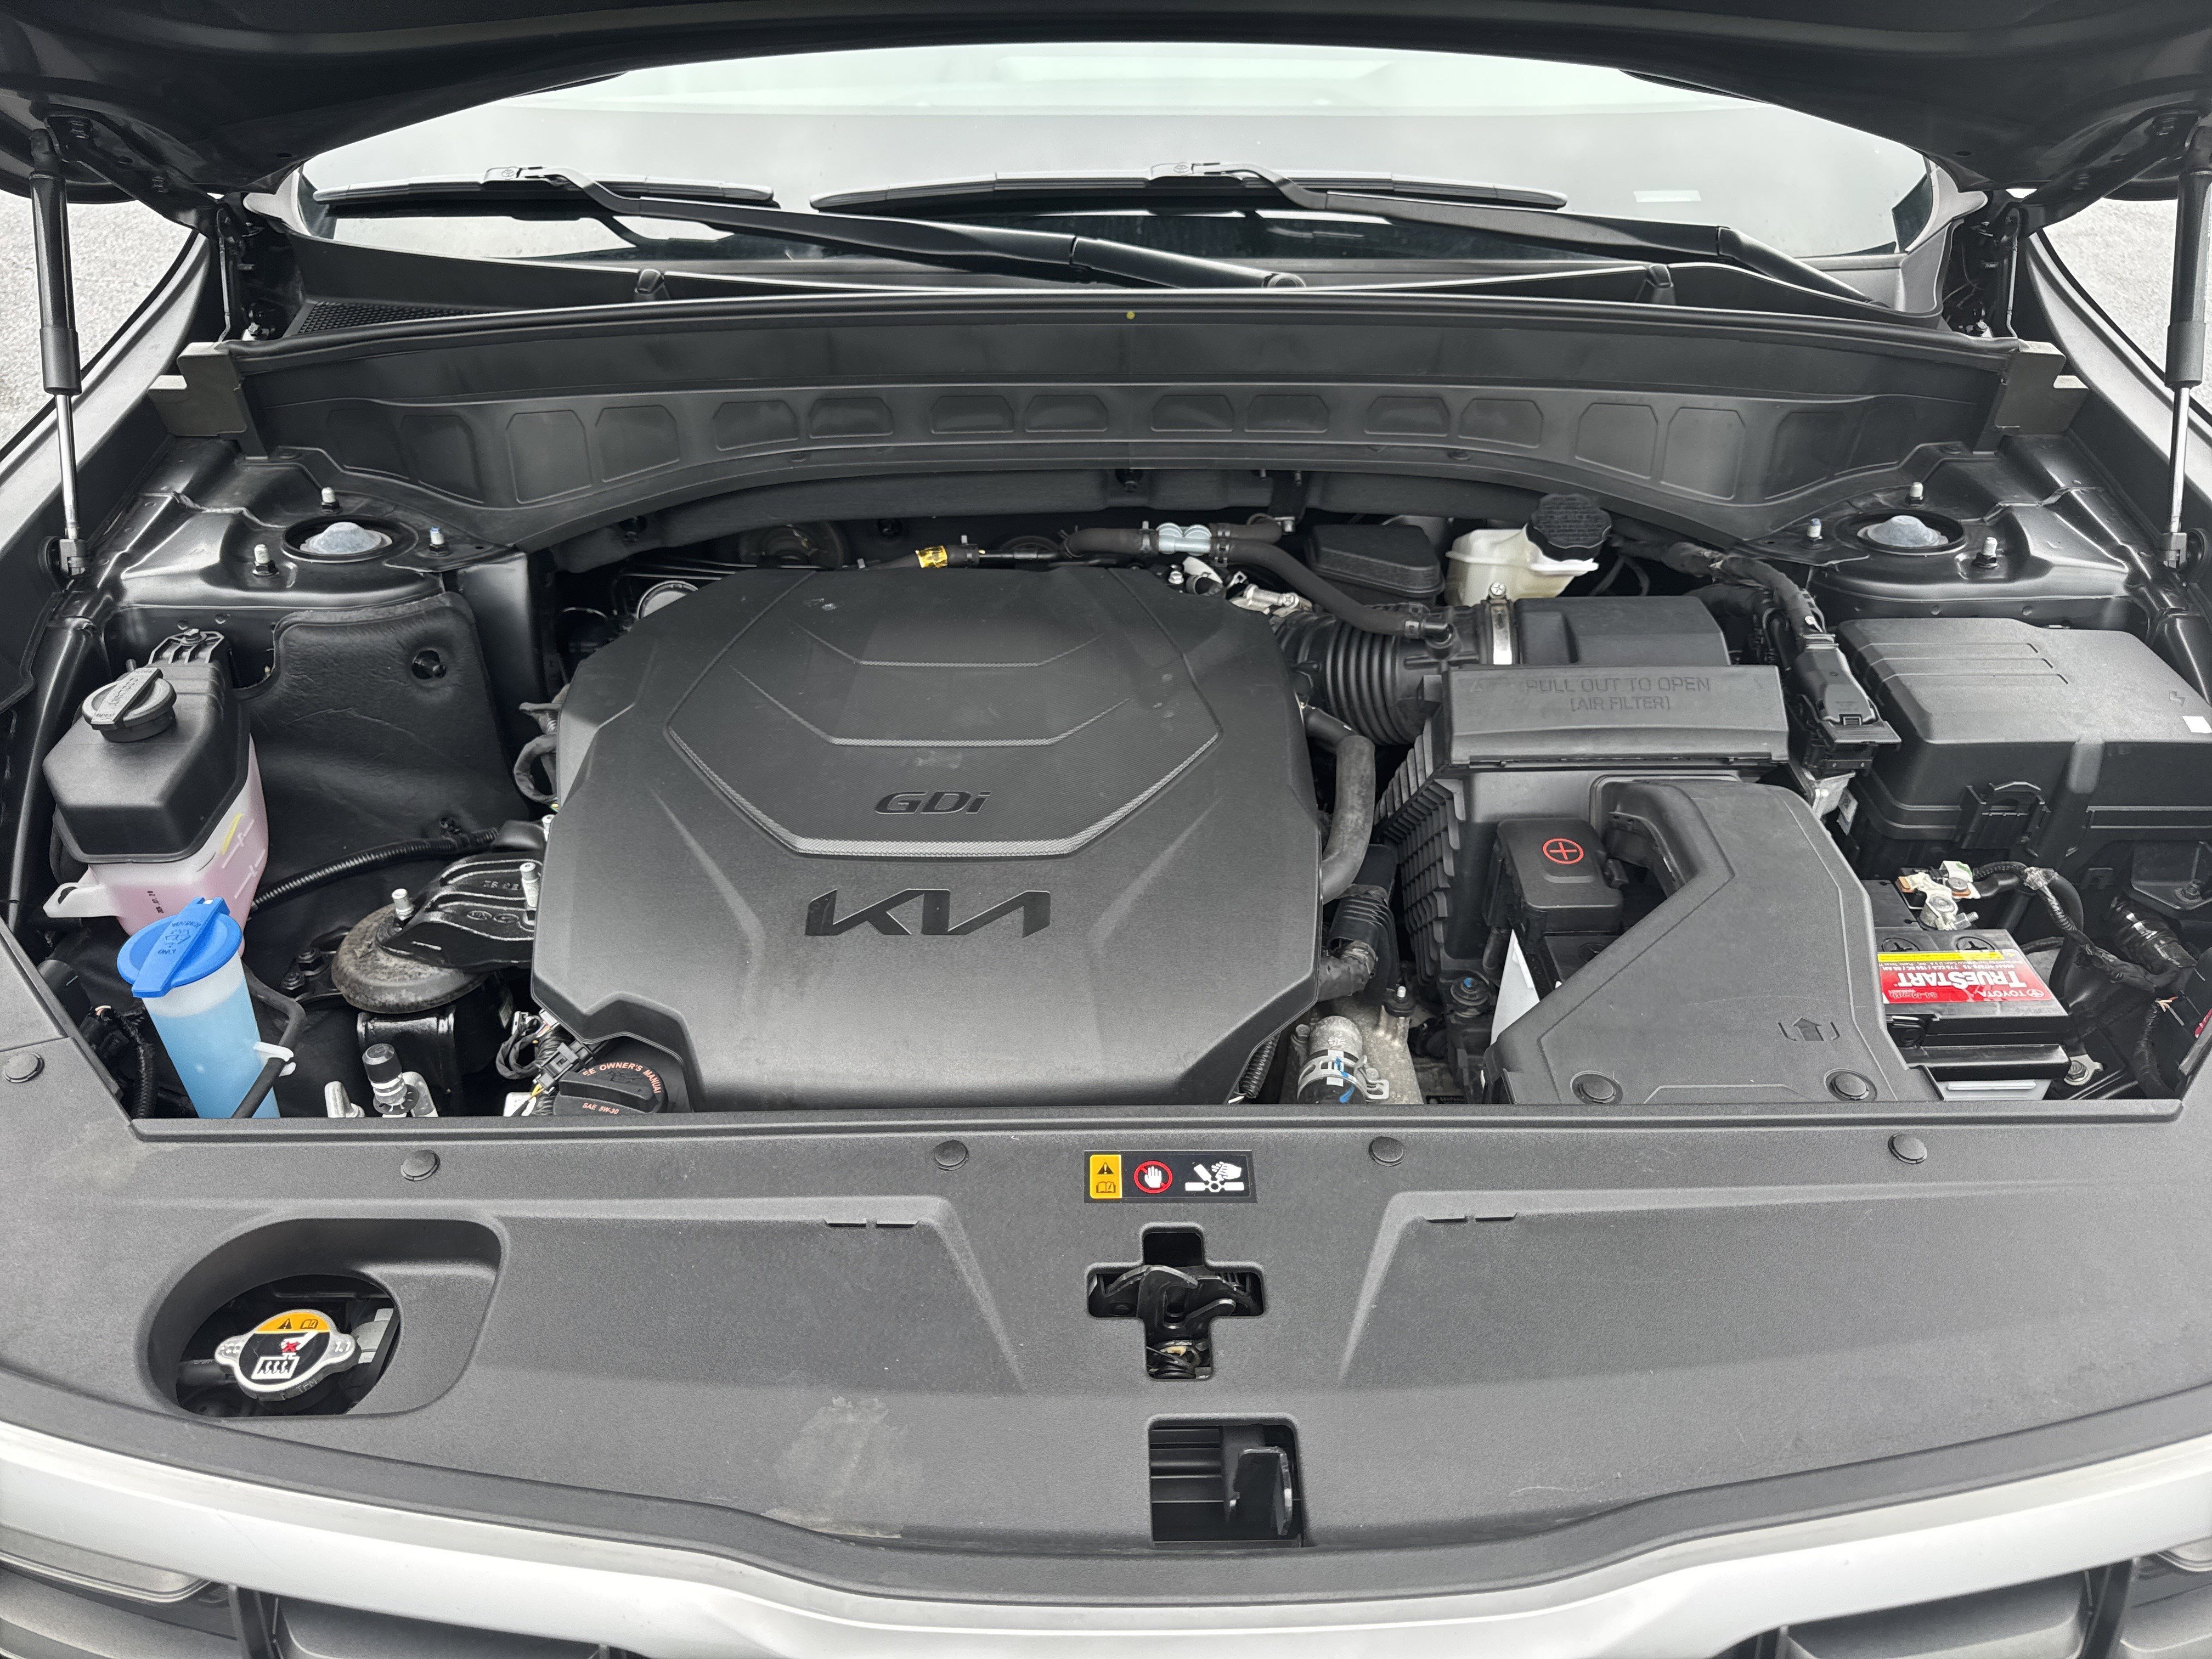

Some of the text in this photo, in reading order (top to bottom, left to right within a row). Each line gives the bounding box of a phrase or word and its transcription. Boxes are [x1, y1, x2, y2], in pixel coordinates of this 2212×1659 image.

[1525, 676, 1710, 693] PULL OUT TO OPEN
[875, 791, 991, 815] GDi
[805, 888, 1051, 939] KIA
[1977, 989, 2027, 997] TOYOTA
[599, 1062, 644, 1071] OWNER'S
[582, 1102, 619, 1115] SAE 5W-30
[335, 1341, 352, 1352] 1.1
